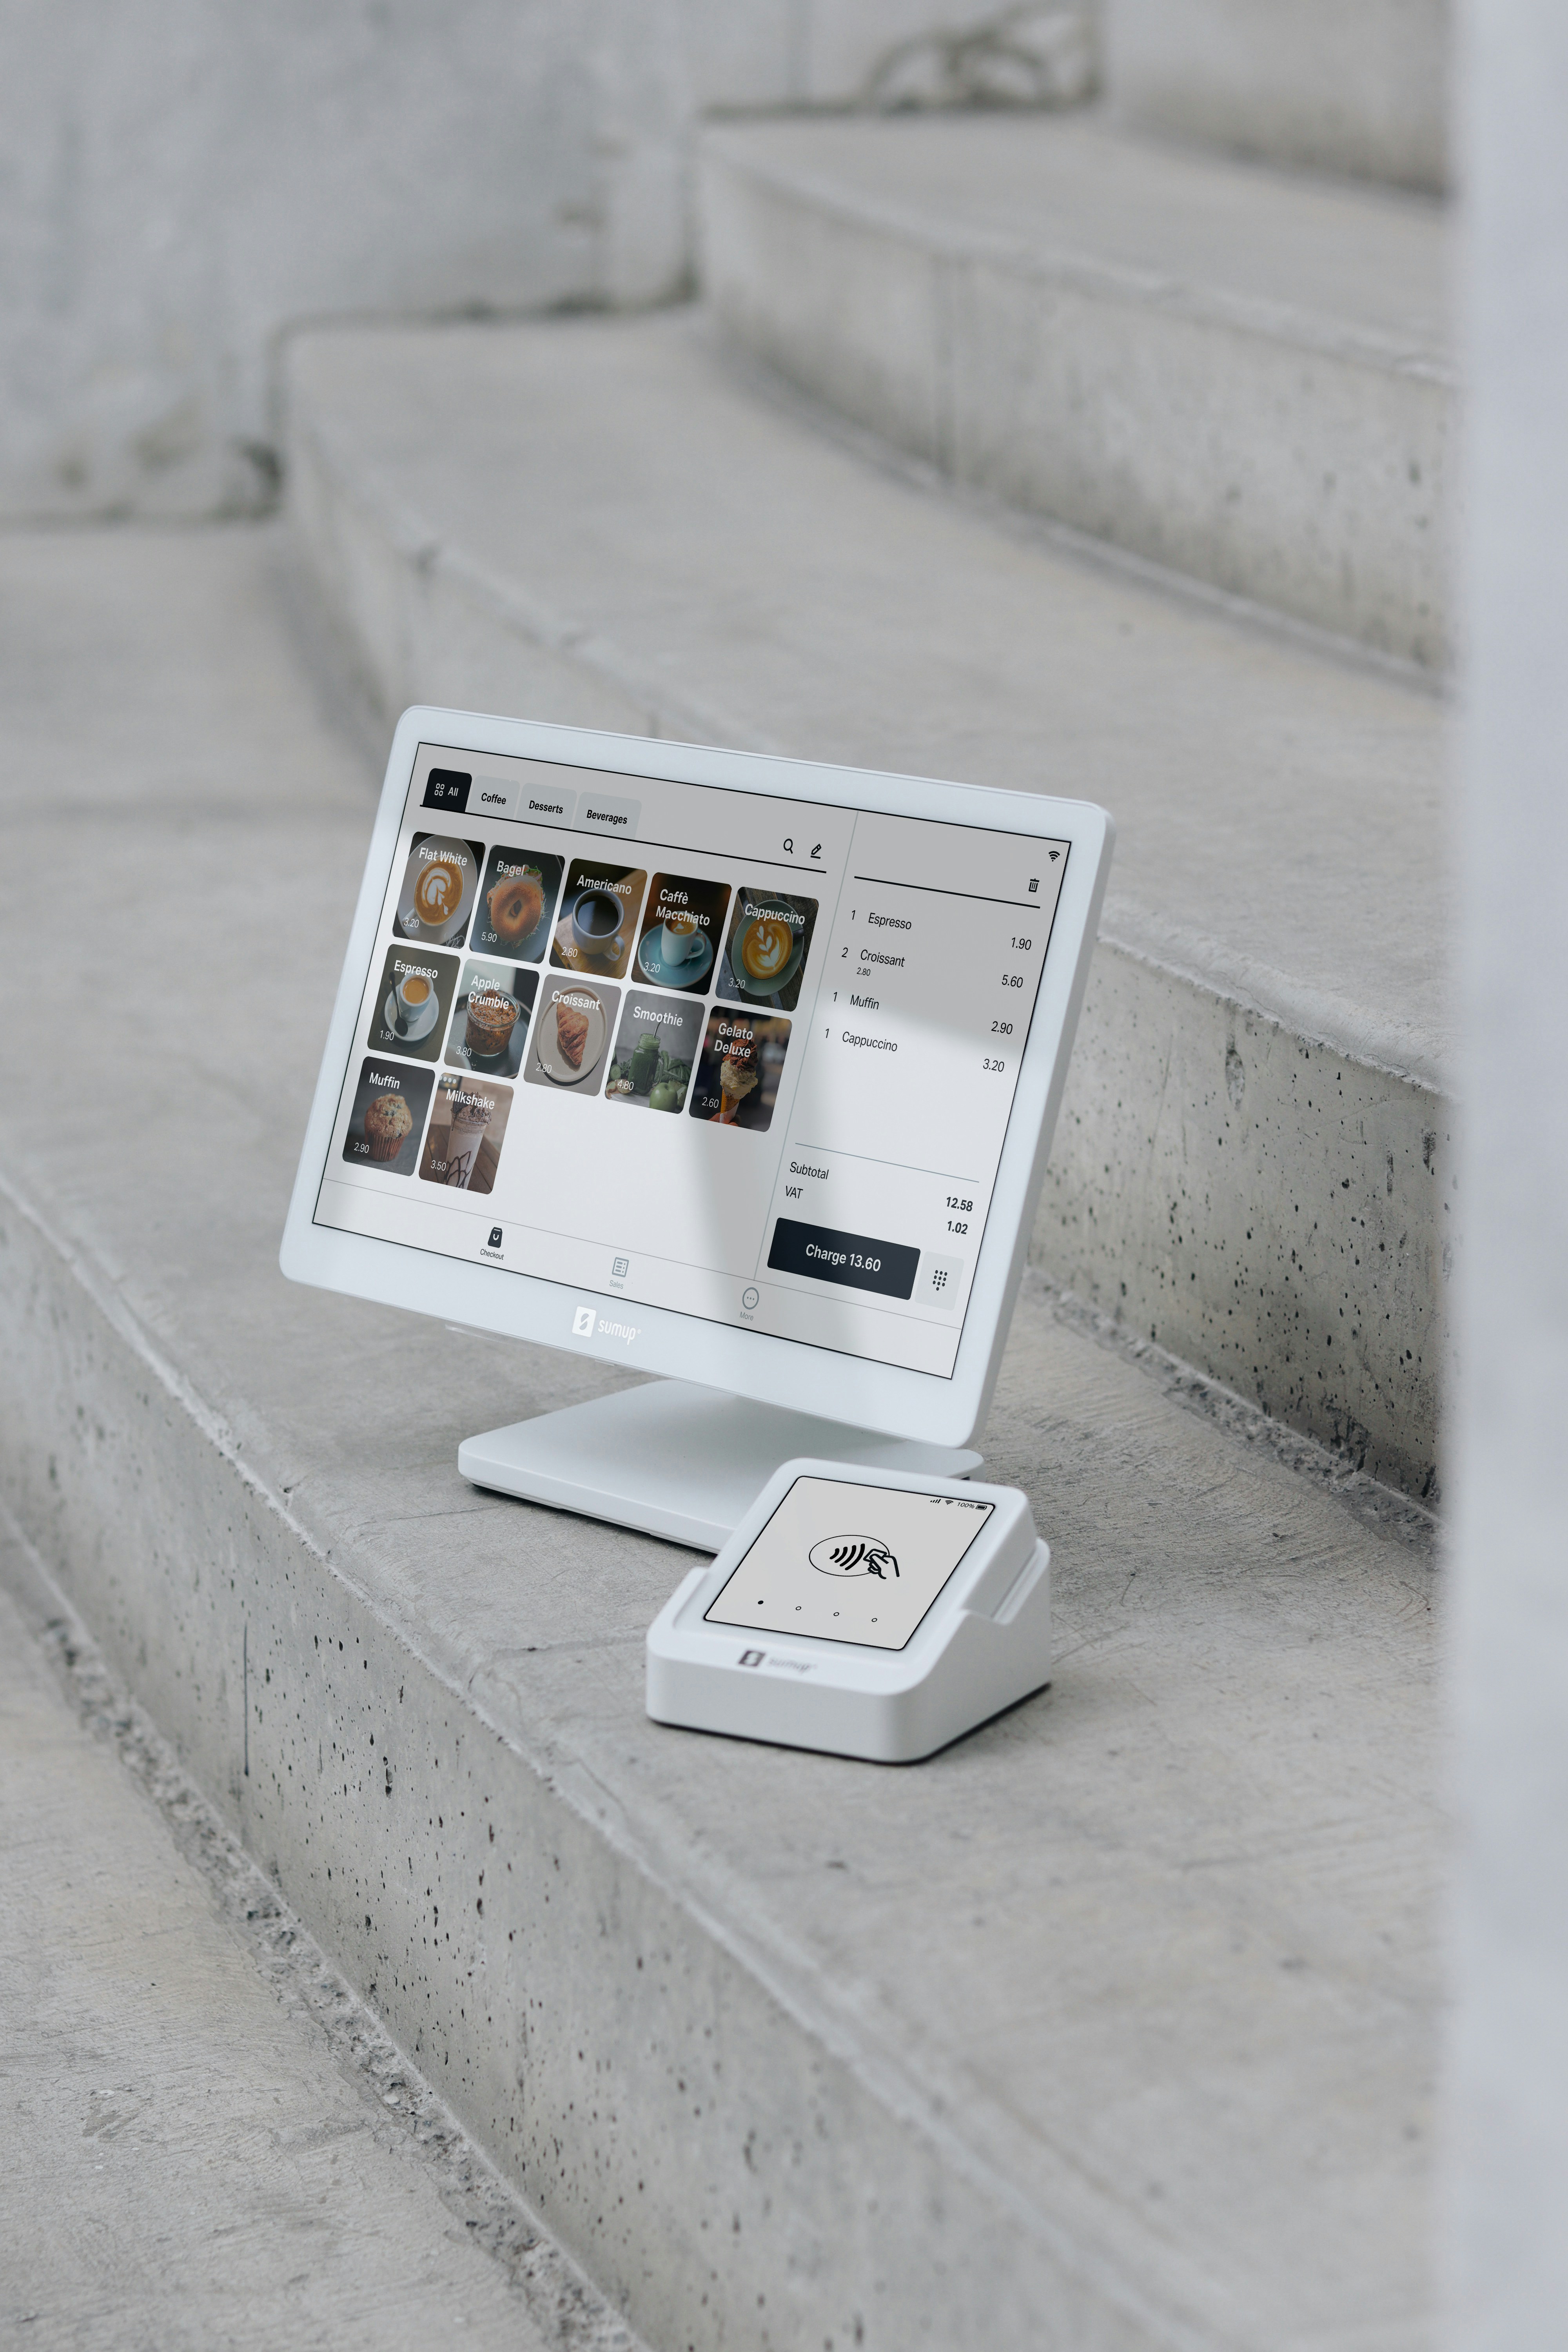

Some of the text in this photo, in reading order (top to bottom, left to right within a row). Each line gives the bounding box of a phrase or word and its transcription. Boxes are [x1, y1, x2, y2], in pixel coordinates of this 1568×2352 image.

[448, 787, 458, 797] All
[481, 793, 506, 805] Coffee
[529, 800, 563, 814] Desserts
[586, 809, 627, 825] Beverages
[419, 847, 467, 866] Flat White
[496, 860, 525, 877] Bagel
[577, 875, 632, 895] Americano
[660, 889, 688, 904] Caffè
[656, 906, 710, 926] Macchiato
[745, 904, 805, 925] Cappuccino
[851, 910, 911, 930] 1 Espresso
[404, 917, 419, 928] 3.20
[481, 932, 497, 942] 5.90
[1011, 937, 1031, 950] 1.90
[561, 947, 577, 958] 2.80
[842, 947, 905, 967] 2 Croissant
[394, 960, 438, 979] Espresso
[644, 962, 660, 973] 3.20
[857, 967, 871, 976] 2.80
[471, 975, 500, 991] Apple
[728, 978, 746, 989] 3.20
[1002, 975, 1023, 988] 5.60
[468, 991, 509, 1010] Crumble
[552, 990, 601, 1010] Croissant
[833, 992, 879, 1009] 1 Muffin
[633, 1006, 683, 1026] Smoothie
[718, 1023, 753, 1040] Gelato
[991, 1021, 1013, 1034] 2.90
[379, 1030, 394, 1041] 1.90
[825, 1029, 897, 1052] 1 Cappuccino
[456, 1046, 472, 1057] 3.80
[714, 1040, 751, 1058] Deluxe
[535, 1062, 552, 1074] 2.80
[983, 1058, 1004, 1072] 3.20
[369, 1072, 400, 1089] Muffin
[617, 1079, 634, 1091] 4.80
[446, 1089, 495, 1110] Milkshake
[702, 1097, 719, 1108] 2.60
[354, 1143, 369, 1153] 2.90
[431, 1160, 446, 1171] 3.50
[789, 1162, 829, 1180] Subtotal
[785, 1186, 803, 1199] VAT
[946, 1197, 973, 1212] 12.58
[947, 1221, 968, 1234] 1.02
[480, 1249, 504, 1260] Checkout
[806, 1244, 881, 1271] Charge 13.60
[609, 1280, 624, 1289] Sales
[740, 1312, 753, 1320] More
